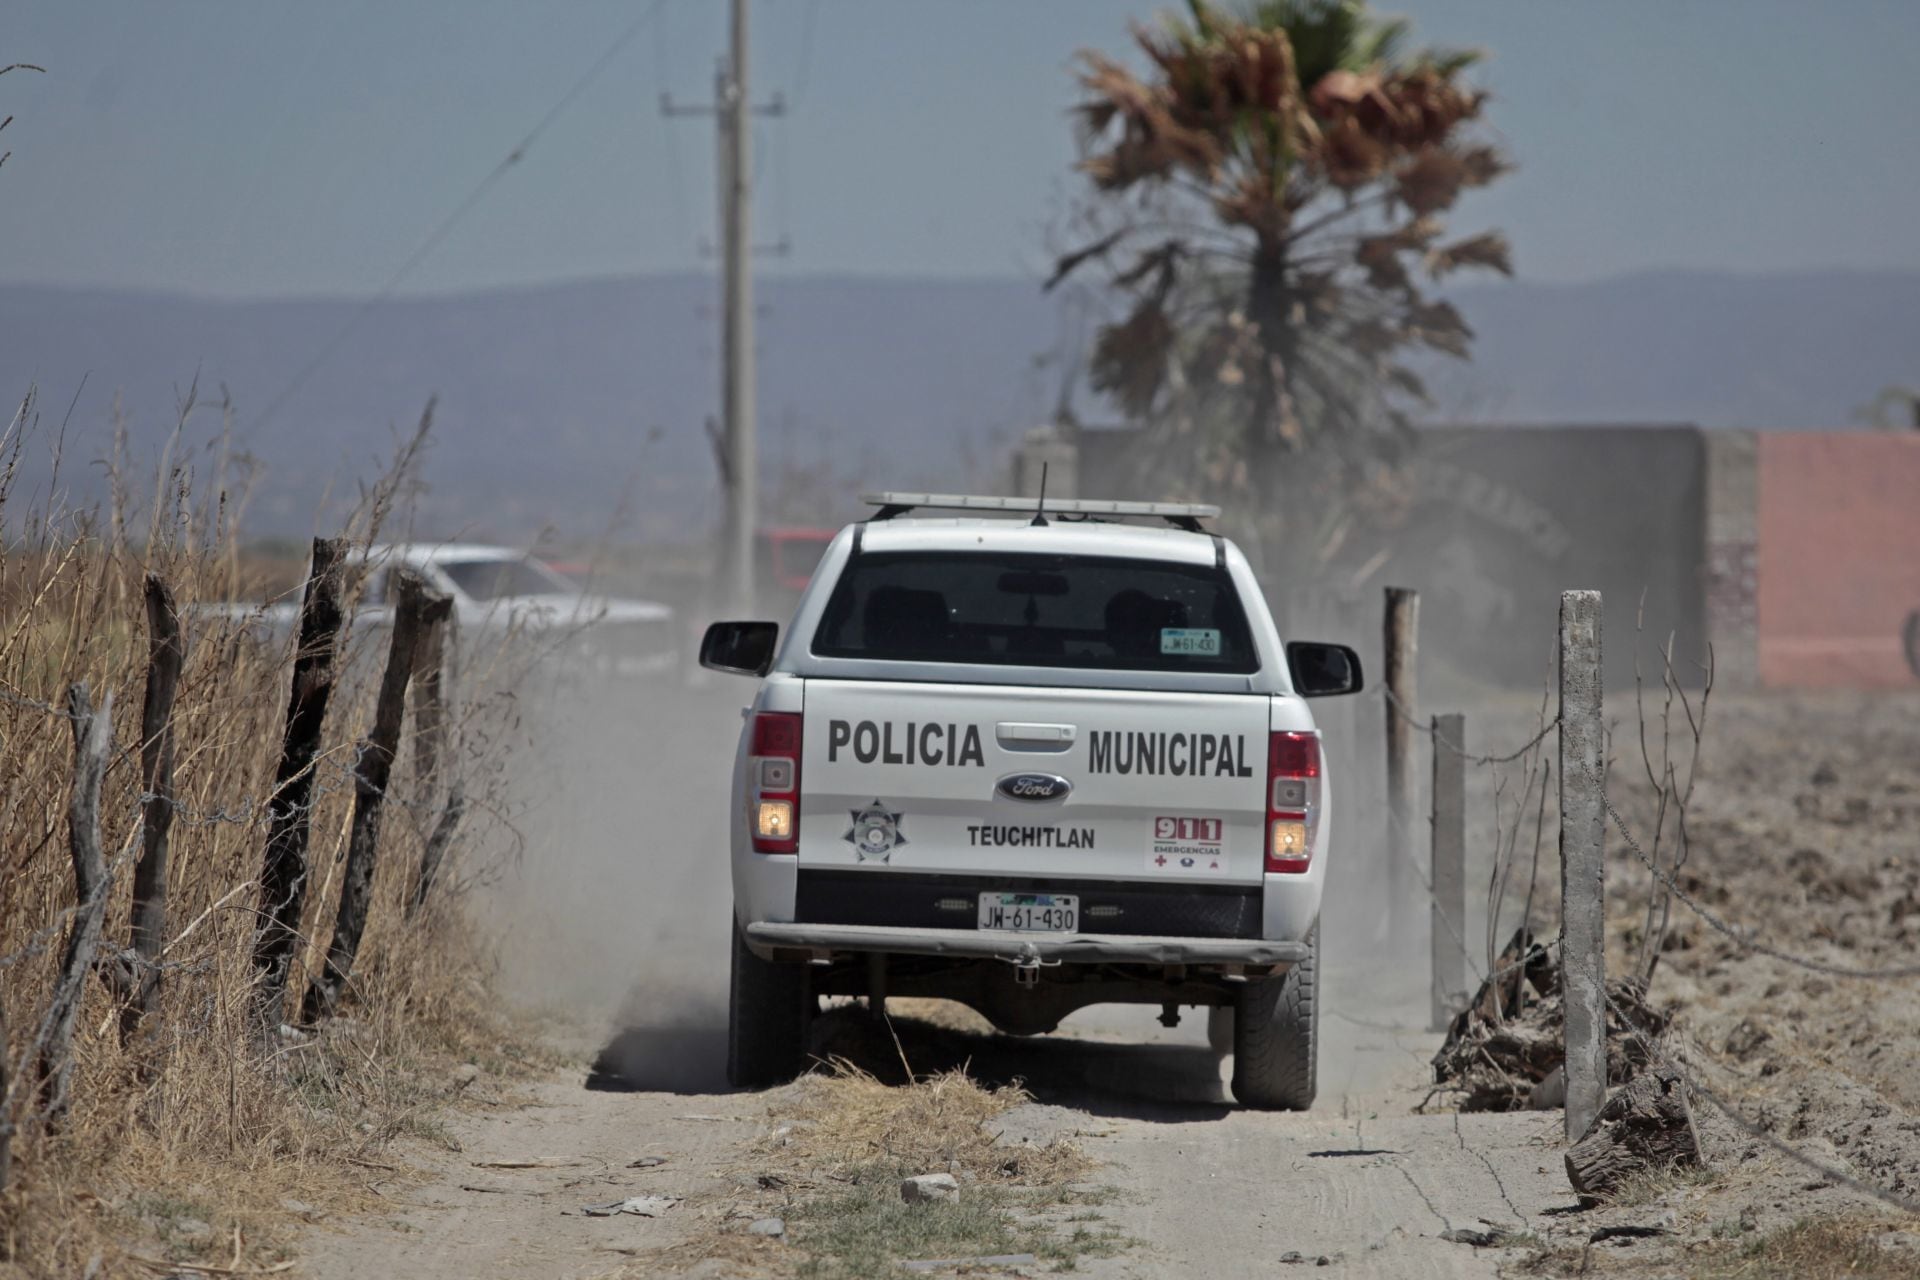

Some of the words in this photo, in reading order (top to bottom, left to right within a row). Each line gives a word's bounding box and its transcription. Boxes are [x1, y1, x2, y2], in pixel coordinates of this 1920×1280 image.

[828, 719, 984, 767] POLICIA
[1089, 730, 1252, 778] MUNICIPAL
[1013, 777, 1054, 796] Ford
[967, 825, 1095, 849] TEUCHITLAN
[1156, 817, 1218, 840] 911
[1154, 846, 1221, 855] EMERGENCIAS
[983, 906, 1074, 929] JW-61-430
